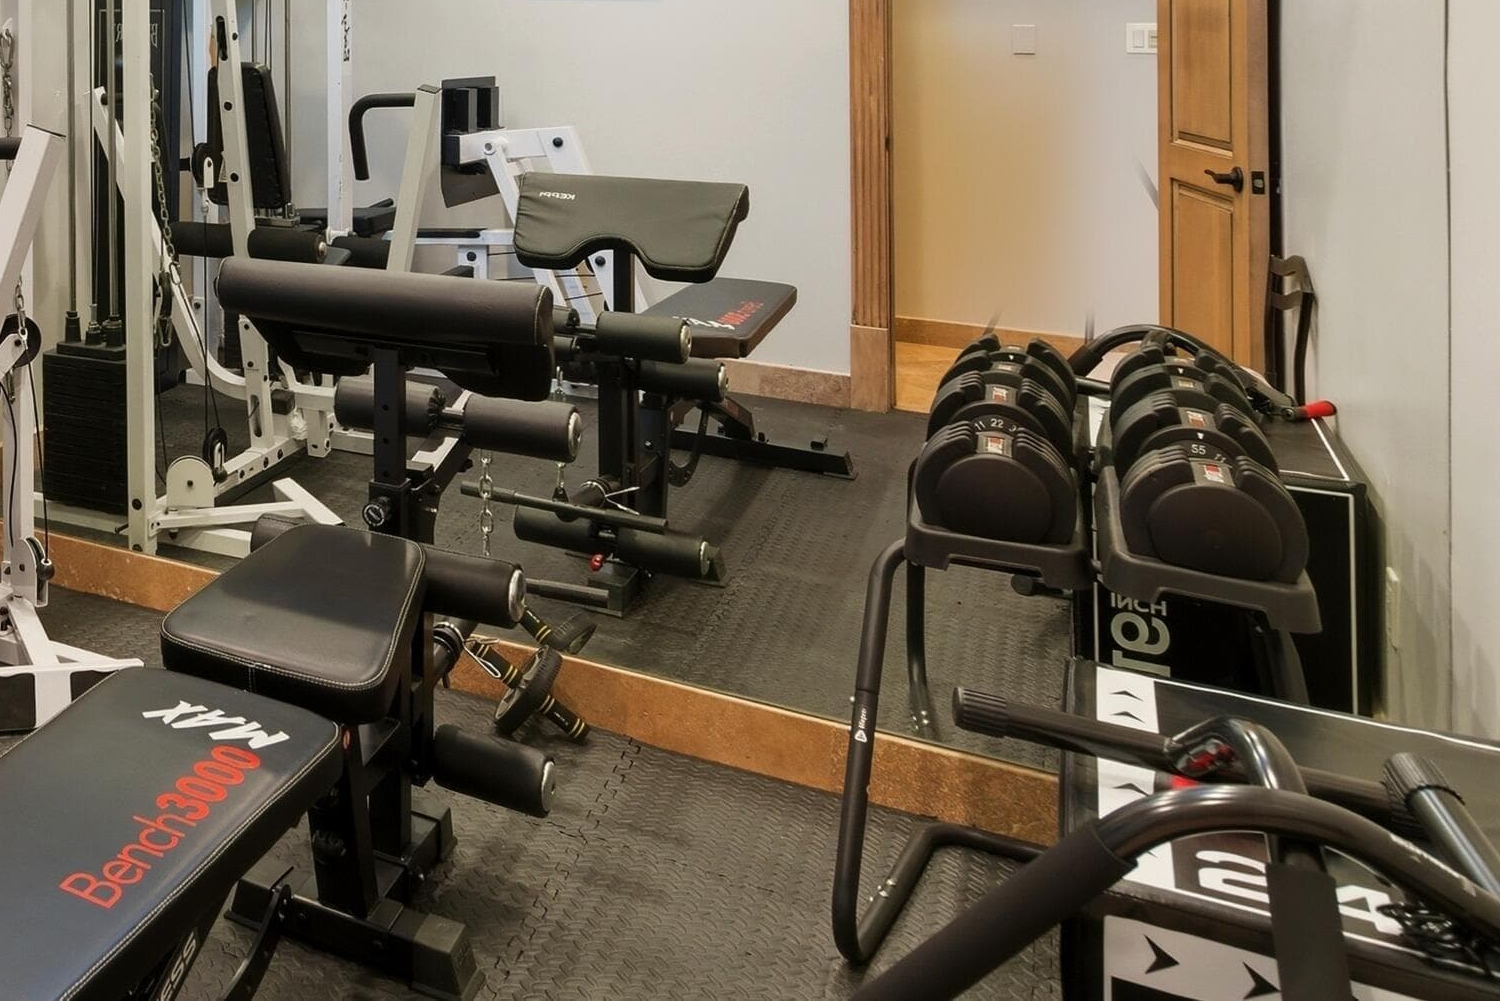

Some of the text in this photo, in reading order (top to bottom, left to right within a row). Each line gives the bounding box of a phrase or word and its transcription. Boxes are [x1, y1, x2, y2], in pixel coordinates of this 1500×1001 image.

[974, 420, 986, 431] 11
[990, 417, 1004, 429] 22
[141, 699, 290, 751] MAX
[58, 744, 262, 910] Bench3000
[157, 931, 197, 1001] ESS
